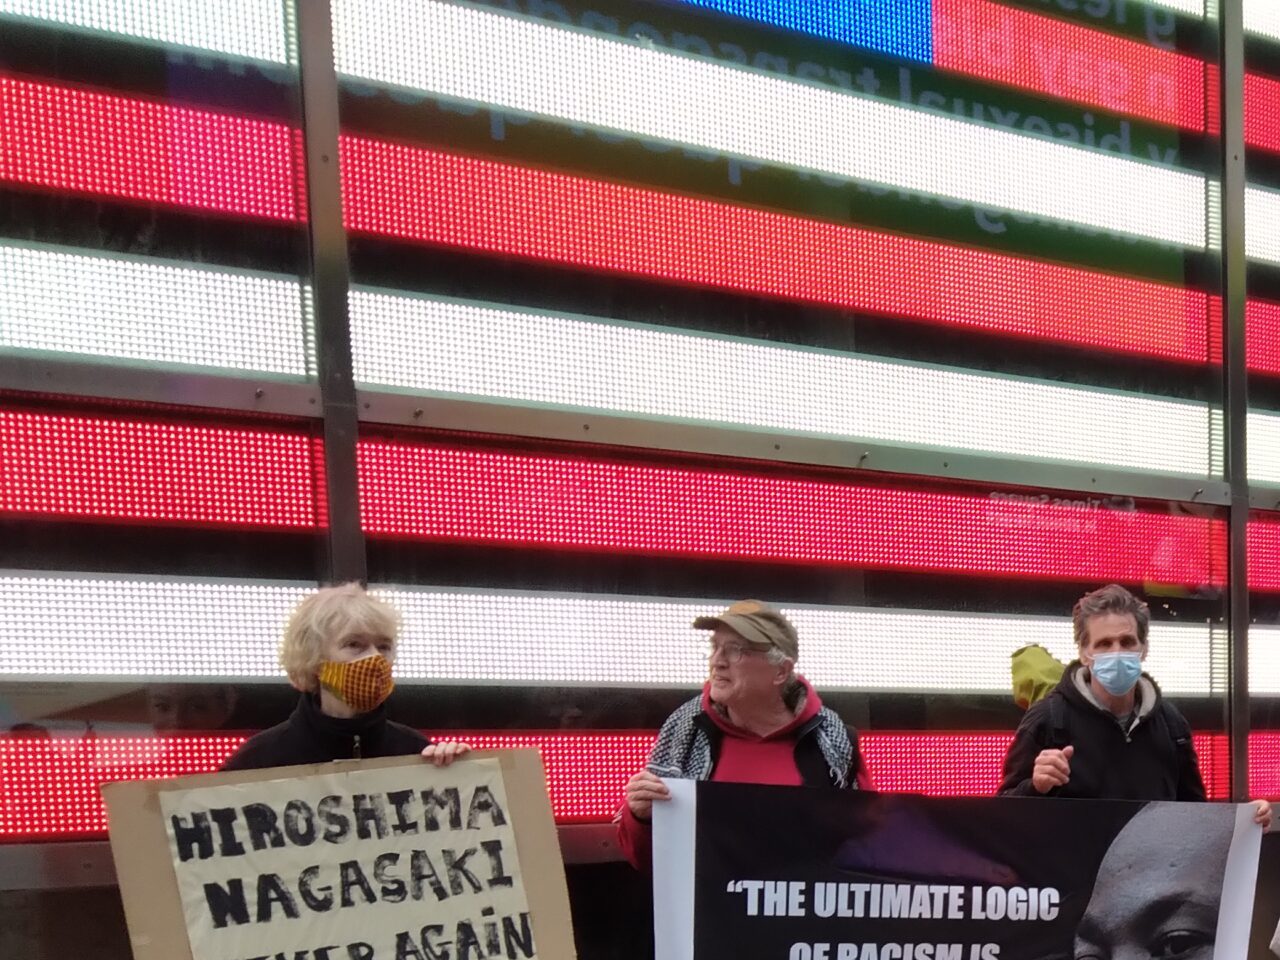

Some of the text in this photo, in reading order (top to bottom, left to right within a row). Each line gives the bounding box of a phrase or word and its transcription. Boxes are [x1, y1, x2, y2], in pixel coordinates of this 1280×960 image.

[171, 785, 507, 862] HIROSHIMA
[203, 840, 514, 929] NAGASAKI
[727, 880, 1060, 921] “THE ULTIMATE LOGIC
